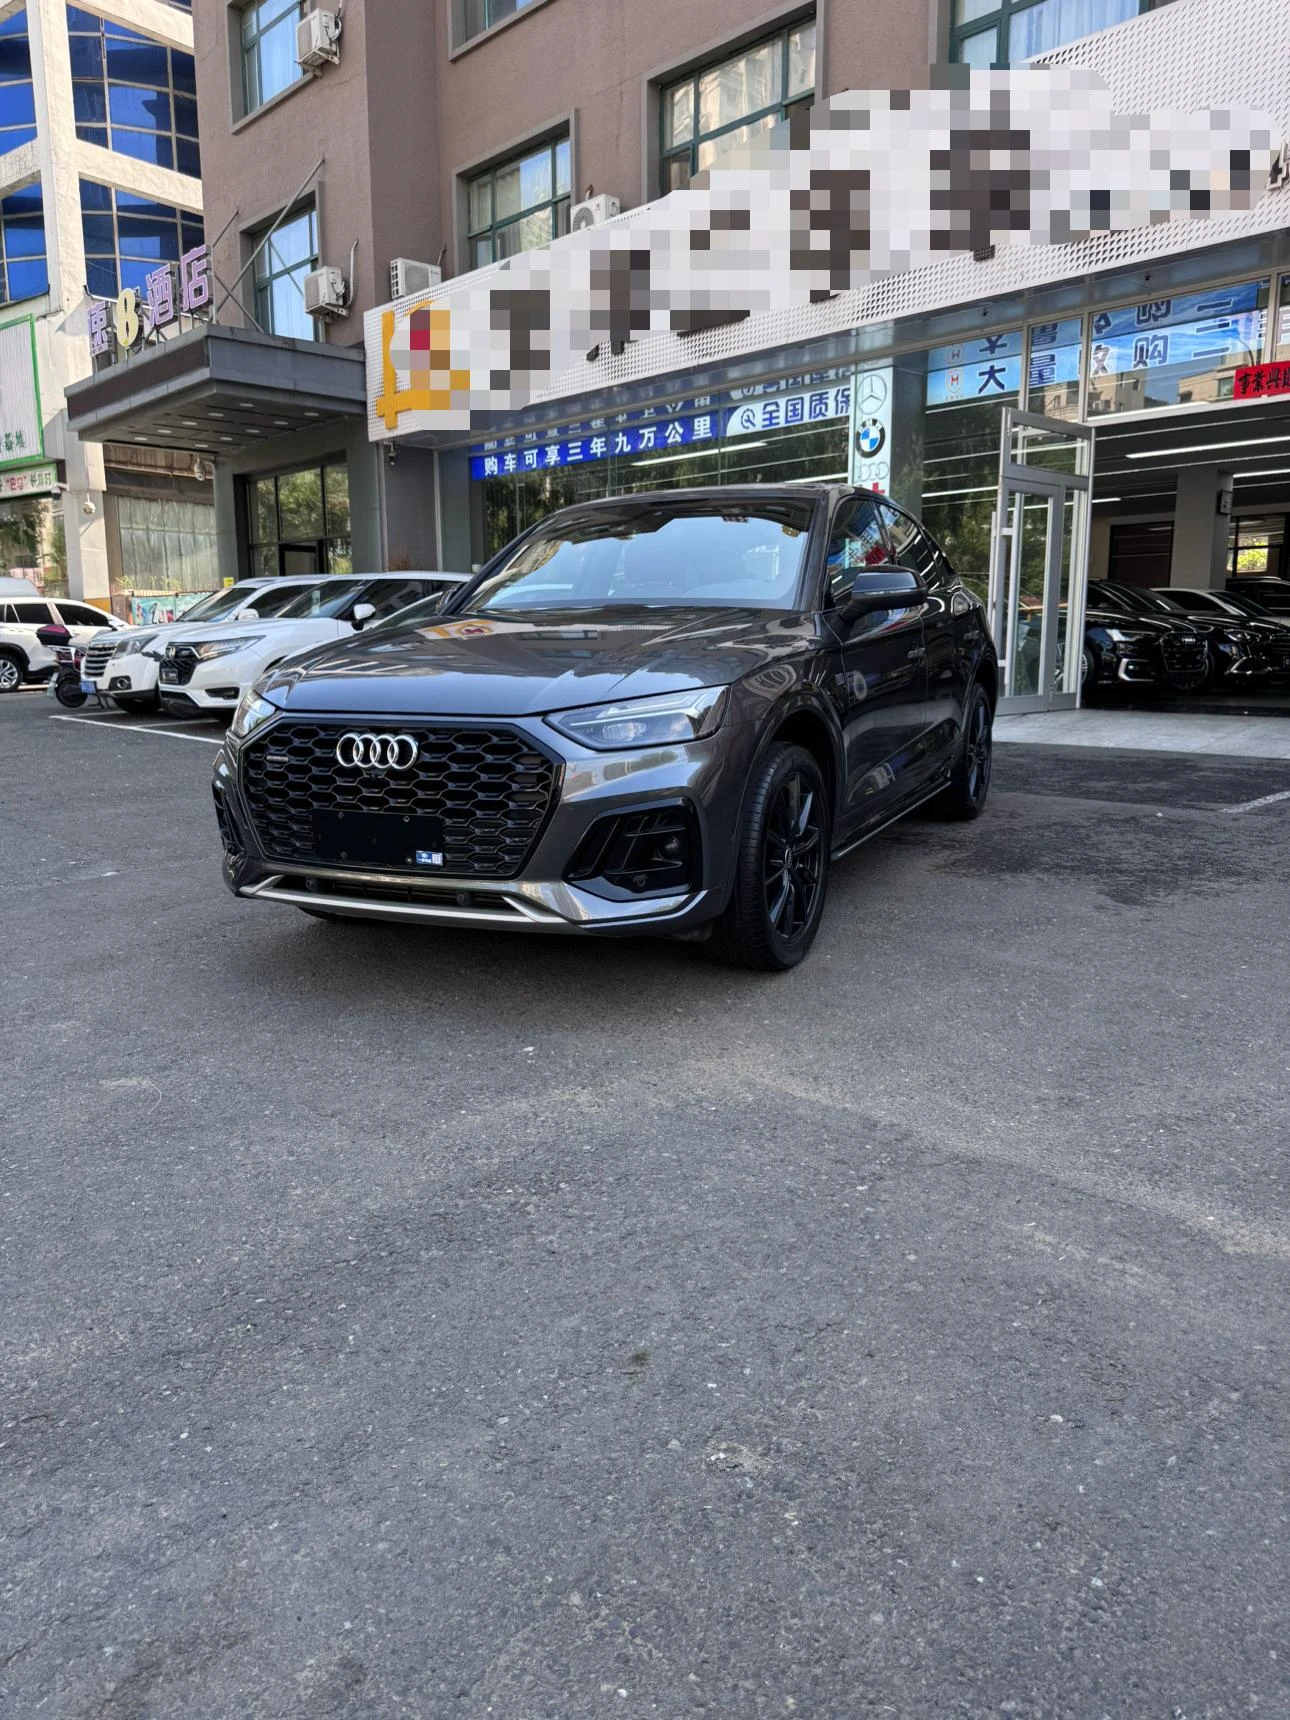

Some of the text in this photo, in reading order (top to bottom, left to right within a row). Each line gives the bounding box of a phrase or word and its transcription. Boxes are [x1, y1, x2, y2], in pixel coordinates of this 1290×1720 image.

[761, 388, 850, 429] 全国质保
[484, 415, 712, 476] 购车可享三年九万公里
